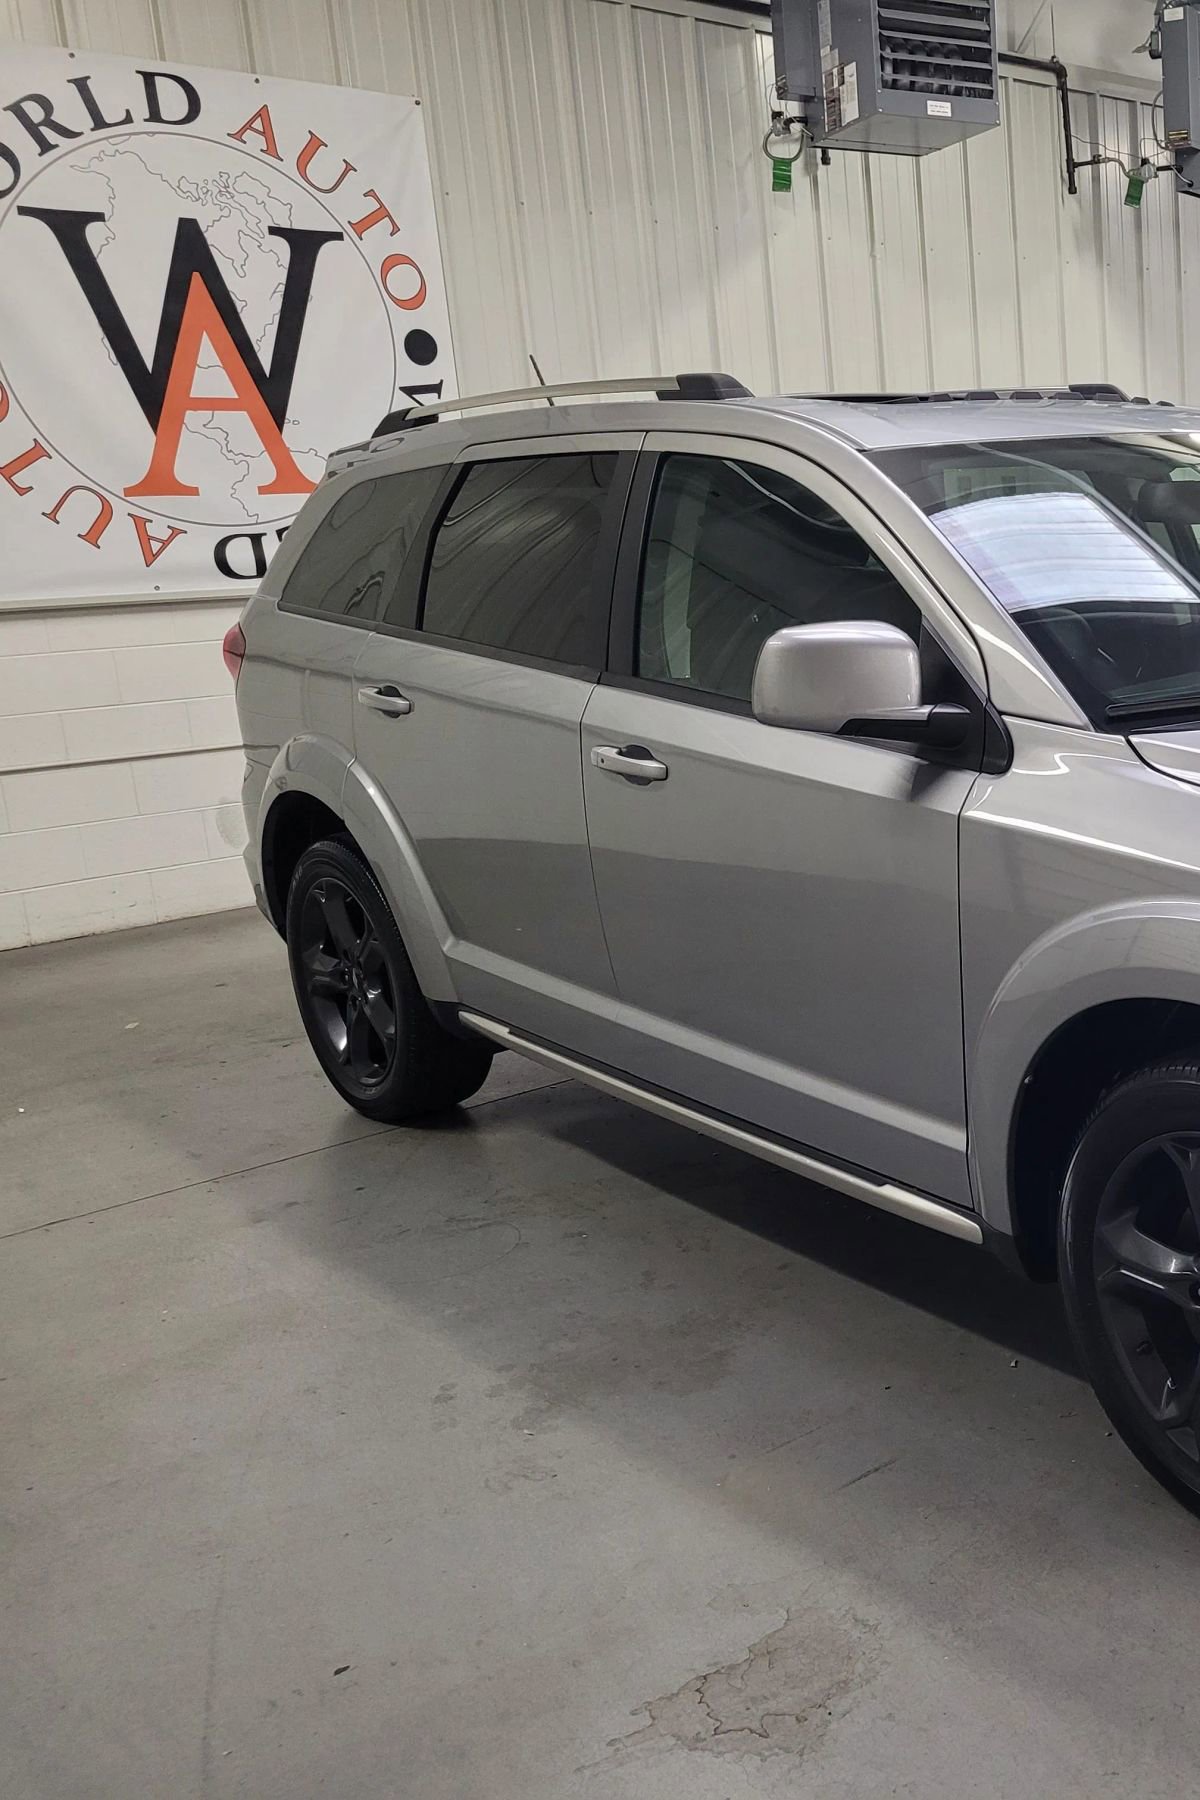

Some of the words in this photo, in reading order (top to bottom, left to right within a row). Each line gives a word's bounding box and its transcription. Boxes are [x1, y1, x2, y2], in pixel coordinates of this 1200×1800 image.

[0, 69, 202, 199] RLD
[227, 104, 428, 310] AUTO
[0, 380, 187, 567] AUT
